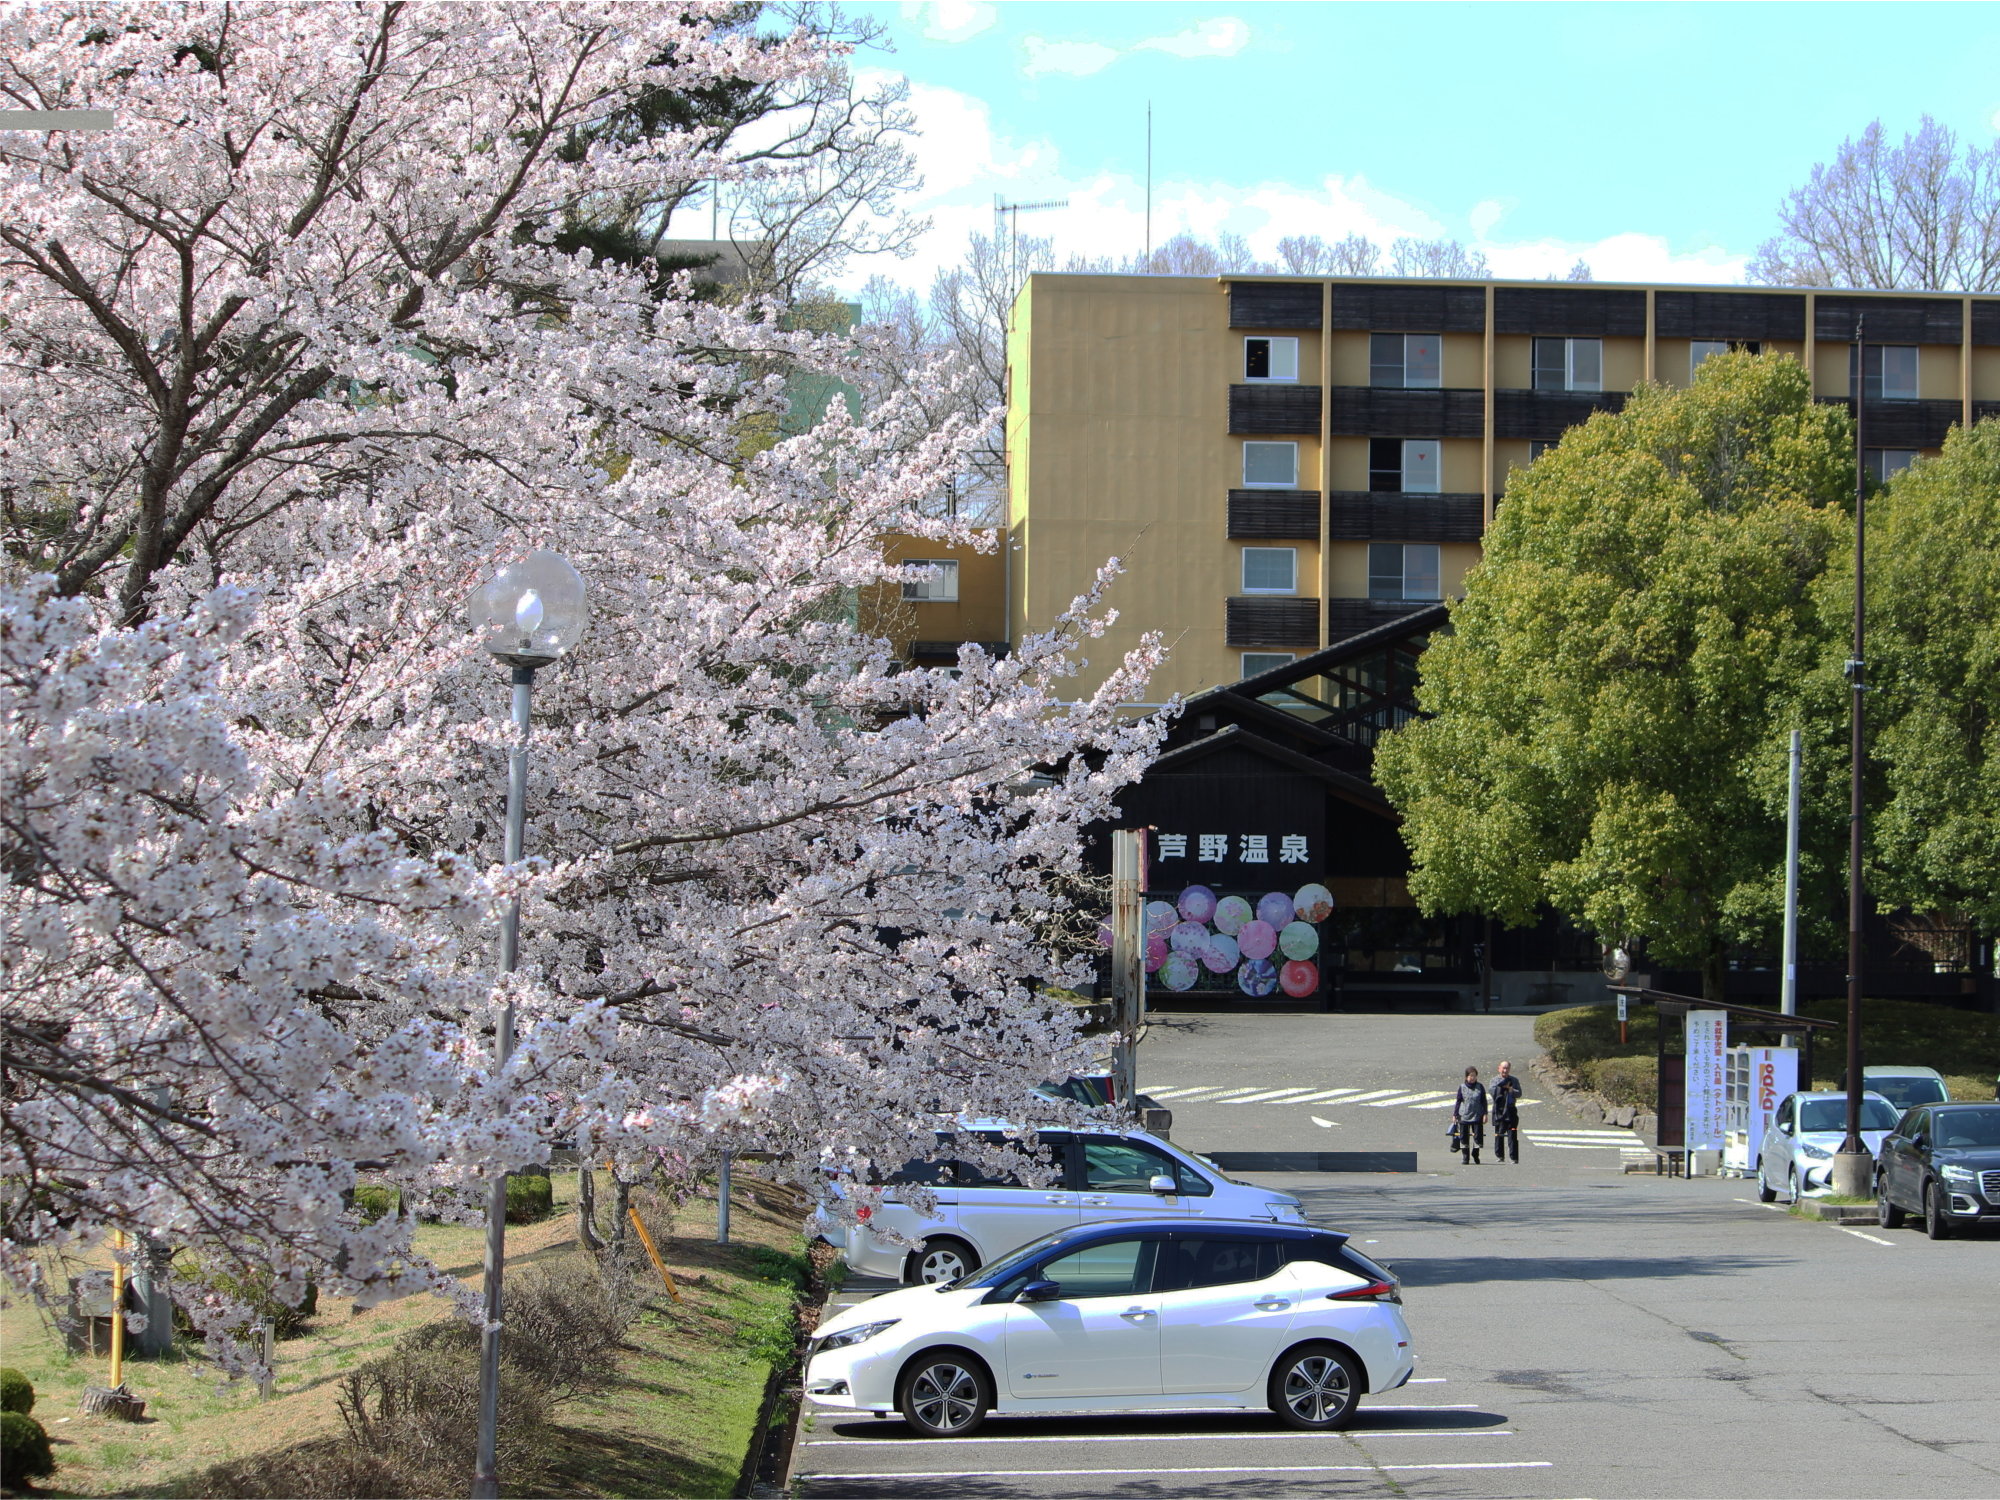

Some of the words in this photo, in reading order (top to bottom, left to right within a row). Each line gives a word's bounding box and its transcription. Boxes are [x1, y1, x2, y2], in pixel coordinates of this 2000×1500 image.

[1157, 833, 1310, 864] 芦野温泉
[1762, 1063, 1777, 1111] DyDo
